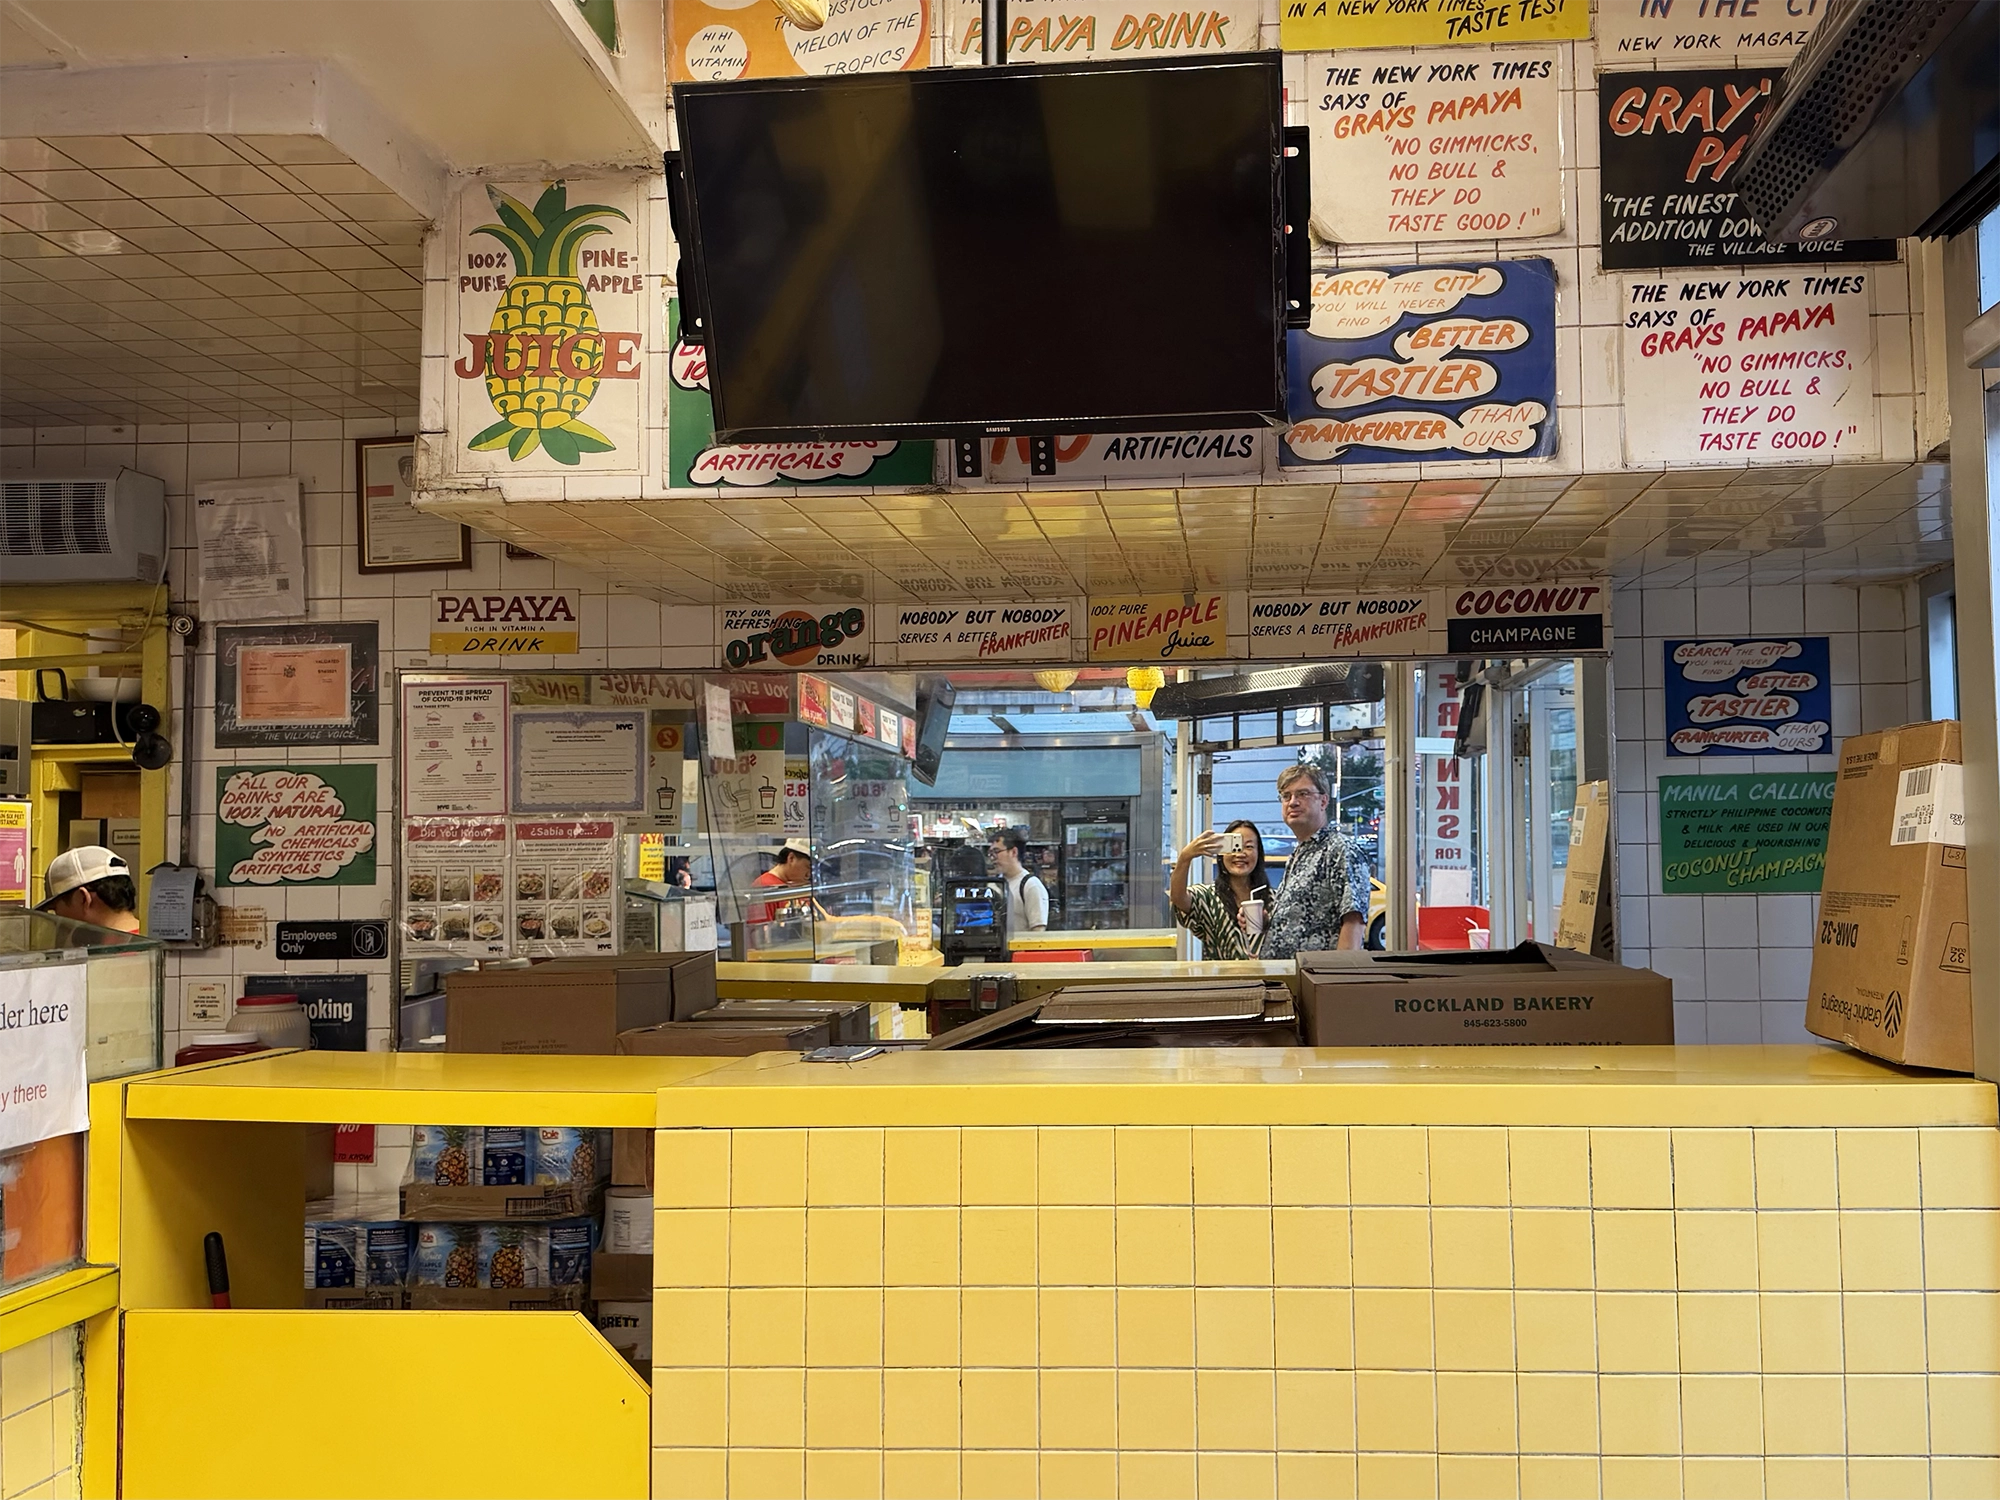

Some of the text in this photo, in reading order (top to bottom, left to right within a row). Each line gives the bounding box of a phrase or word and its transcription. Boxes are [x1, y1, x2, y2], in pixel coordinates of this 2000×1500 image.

[1110, 10, 1230, 51] DRINK
[1446, 7, 1510, 40] TASTE
[702, 31, 733, 41] HI HI
[793, 12, 920, 57] MELON OF THE
[1618, 34, 1722, 52] NEW YORK
[710, 44, 725, 54] IN
[691, 58, 747, 68] VITAMIN
[823, 47, 905, 76] TROPICS
[1326, 60, 1553, 87] THE NEW YORK TIMES
[1319, 92, 1408, 111] SAYS OF
[1333, 87, 1523, 141] GRAYS PAPAYA
[1428, 133, 1539, 156] GIMMICKS,
[1388, 159, 1508, 182] NO BULL &
[1391, 187, 1482, 208] THEY DO
[1662, 193, 1739, 216] FINEST
[1387, 213, 1448, 233] TASTE
[1609, 218, 1714, 243] ADDITION
[1687, 240, 1845, 257] THE VILLAGE VOICE
[467, 248, 639, 269] 100% PINE-
[586, 274, 644, 295] APPLE
[1311, 273, 1486, 297] EARCH THE CITY
[1631, 275, 1865, 304] THE NEW YORK TIMES
[1315, 298, 1446, 313] YOU WILL NEVER
[1337, 317, 1370, 327] FIND
[1625, 308, 1717, 329] SAYS OF
[1410, 323, 1516, 349] BETTER
[1640, 302, 1836, 358] GRAYS PAPAYA
[454, 332, 643, 380] JUICE
[1740, 350, 1853, 373] GIMMICKS,
[1329, 363, 1483, 399] TASTIER
[1700, 376, 1821, 399] NO BULL &
[1471, 407, 1533, 424] THAN
[1701, 405, 1796, 425] THEY DO
[1288, 420, 1447, 444] FRANKFURTER
[1463, 429, 1524, 447] OURS
[1699, 432, 1761, 451] TASTE
[1103, 434, 1254, 461] ARTIFICIALS
[700, 452, 844, 471] ARTIFICALS
[437, 596, 576, 623] PAPAYA
[1090, 604, 1148, 616] 100% PURE
[1252, 599, 1422, 618] NOBODY BUT NOBODY
[1455, 587, 1601, 616] COCONUT
[725, 609, 771, 618] TRY OUR
[899, 608, 1066, 625] NOBODY BUT NOBODY
[724, 617, 803, 630] REFRESHING
[1094, 596, 1222, 651] PINEAPPLE
[1252, 623, 1353, 636] SERVES BETTER
[1333, 613, 1427, 649] FRANKFURTER
[463, 637, 544, 651] DRINK
[726, 607, 865, 669] orange
[899, 632, 998, 644] SERVES BETTER
[979, 622, 1071, 657] FRANKFURTER
[1161, 630, 1215, 658] Juice
[1470, 627, 1576, 643] CHAMPAGNE
[817, 654, 862, 666] DRINK
[1678, 645, 1792, 658] SEARCH THE CITY
[1747, 675, 1811, 690] BETTER
[1698, 698, 1791, 717] TASTIER
[284, 731, 322, 740] VILLAGE
[1673, 731, 1769, 744] FRANKFURTER
[1782, 724, 1821, 734] THAN
[1778, 737, 1815, 748] OURS
[238, 777, 309, 790] ALL OUR
[1664, 781, 1836, 802] MANILA CALLING
[223, 791, 329, 805] DRINKS ARE
[225, 805, 344, 819] 100% NATURAL
[1665, 806, 1833, 819] STRICTLY PHILIPPINE COCONUTS
[294, 824, 371, 836] ARTIFICIAL
[420, 828, 457, 837] Did You
[1696, 821, 1829, 833] MILK ARE USED OUR
[281, 838, 359, 849] CHEMICALS
[1683, 837, 1821, 848] DELICIOUS NOURISHING
[258, 851, 345, 862] SYNTHETICS
[1665, 847, 1758, 881] COCONUT
[234, 863, 322, 875] ARTIFICALS
[281, 930, 338, 943] Employees
[281, 943, 305, 955] Only
[29, 999, 69, 1026] here
[1394, 996, 1595, 1014] ROCKLAND BAKERY
[1463, 1018, 1527, 1028] 845-623-5800
[1852, 1004, 1882, 1029] Graphic
[13, 1083, 48, 1105] there
[541, 1129, 559, 1140] Dole
